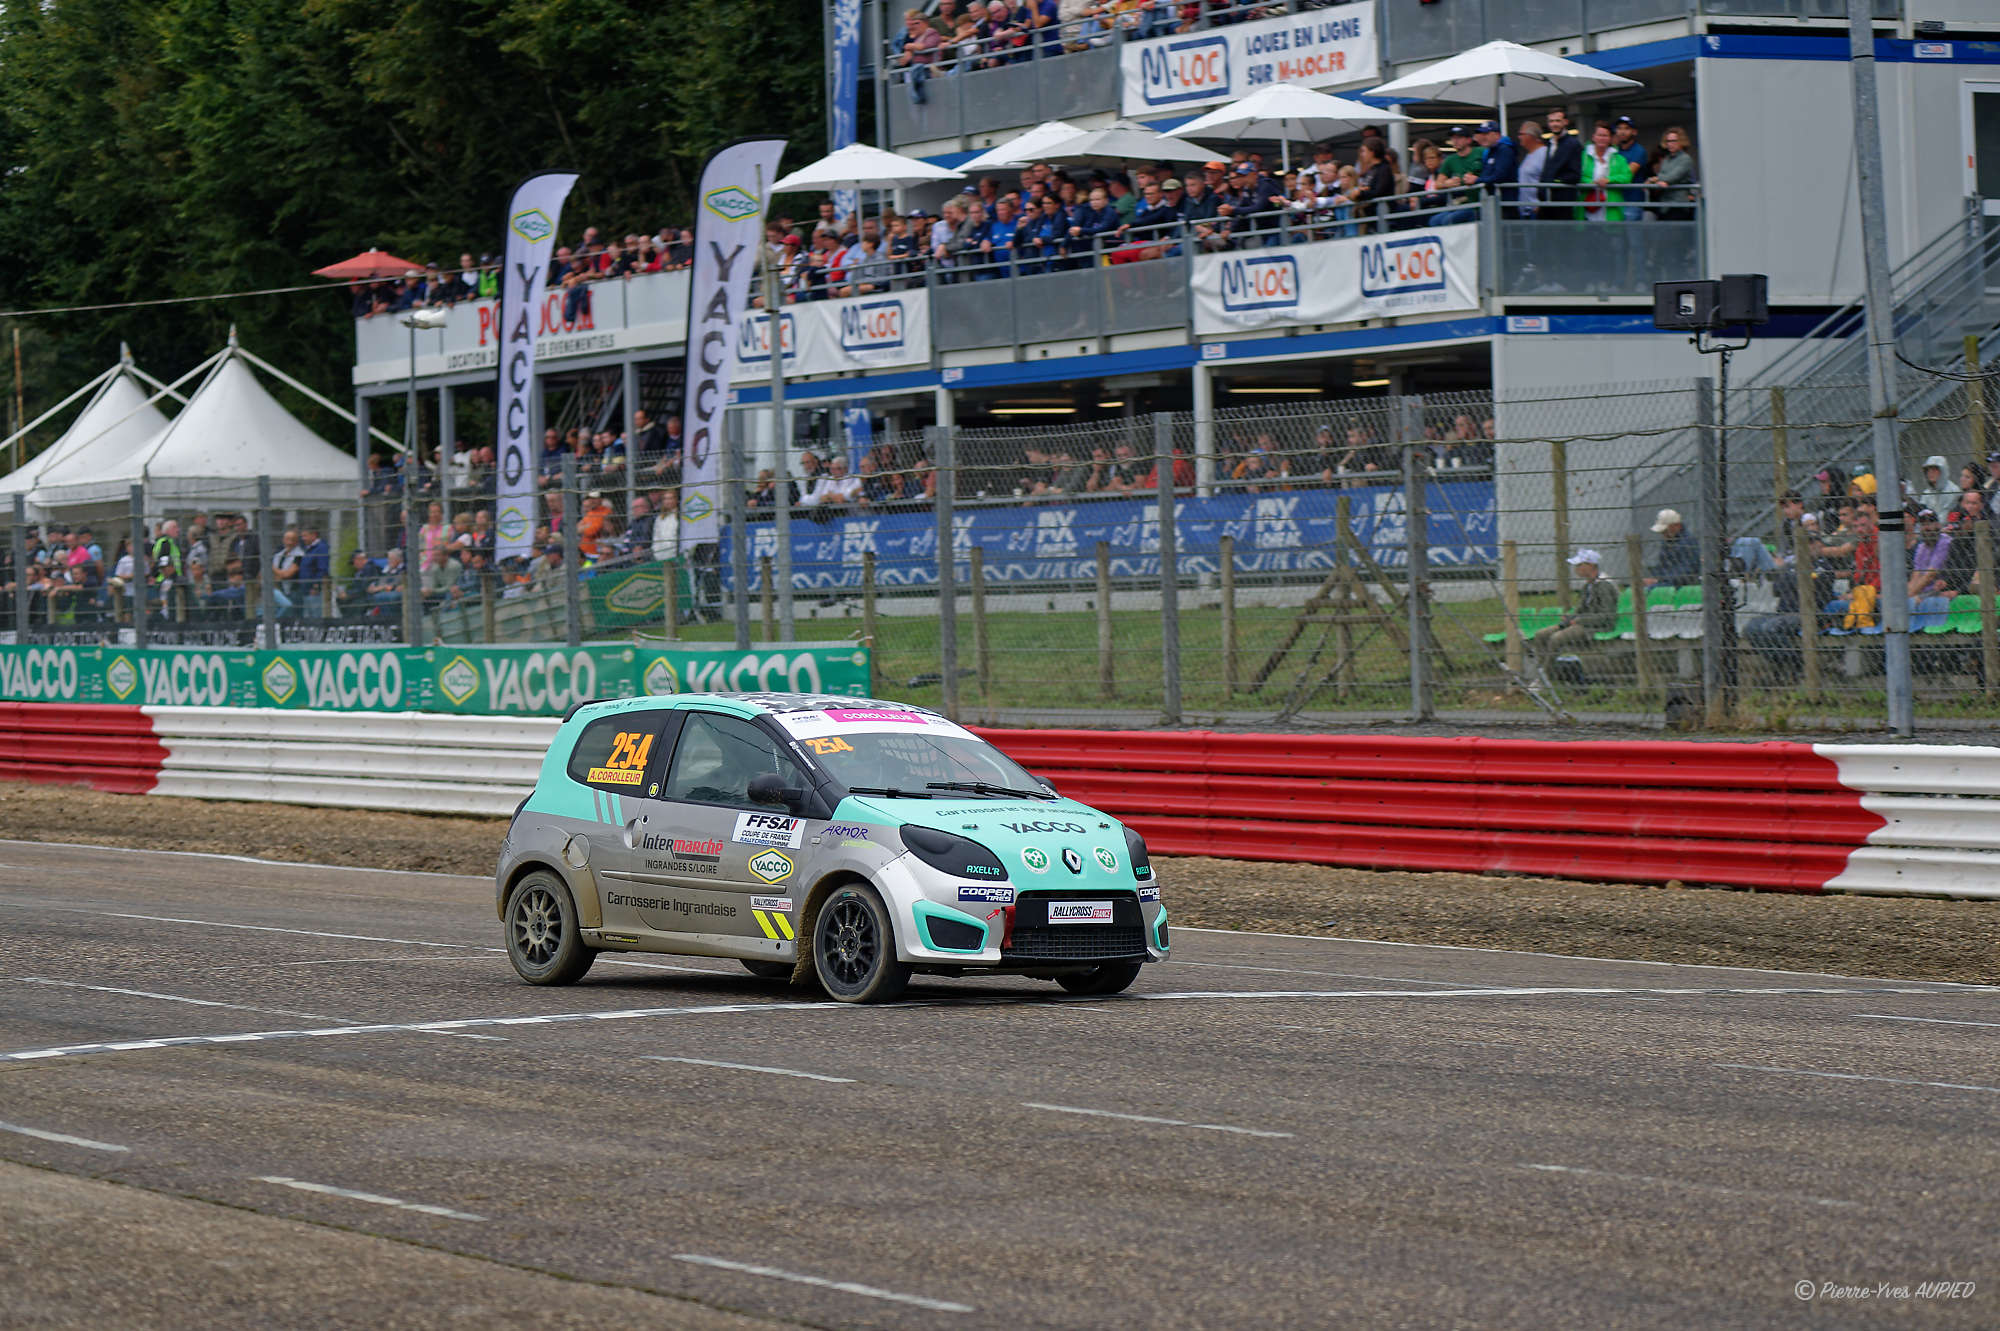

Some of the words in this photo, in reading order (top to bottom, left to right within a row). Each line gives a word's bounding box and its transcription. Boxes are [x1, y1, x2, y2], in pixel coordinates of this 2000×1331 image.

[1246, 29, 1289, 56] LOUEZ
[1294, 25, 1313, 48] EN
[1318, 17, 1361, 44] LIGNE
[1142, 44, 1219, 89] M-LOC
[1247, 63, 1273, 86] SUR
[1277, 51, 1346, 81] M-LOC.FR
[1221, 259, 1290, 298] M-LOC
[1361, 243, 1436, 283] M-LOC
[738, 317, 790, 351] M-LC
[842, 304, 897, 340] M-LOC
[691, 240, 746, 470] YACCO
[504, 263, 541, 487] YACCO
[0, 649, 78, 699] YACCO
[139, 653, 229, 706] YACCO
[299, 651, 403, 708] YACCO
[483, 651, 596, 712] YACCO
[685, 652, 822, 693] YACCO
[605, 731, 654, 770] 254
[805, 736, 854, 755] 254
[590, 771, 641, 784] A.COROLLEUR
[746, 814, 790, 831] FFSA
[934, 804, 1018, 817] Carrosserie
[1000, 820, 1087, 834] YACCO
[643, 833, 724, 859] Intermarché
[741, 829, 761, 839] COUPE
[769, 832, 792, 842] FRANCE
[821, 825, 869, 840] ARMOR
[645, 859, 687, 872] INGRANDES
[688, 862, 718, 874] S/LOIRE
[754, 860, 789, 872] YACCO
[966, 865, 1000, 876] AXELL'R
[607, 891, 670, 910] Carrosserie
[673, 898, 737, 918] Ingrandaise
[960, 888, 1013, 897] COOPER
[1053, 905, 1092, 917] RALLYCROSS
